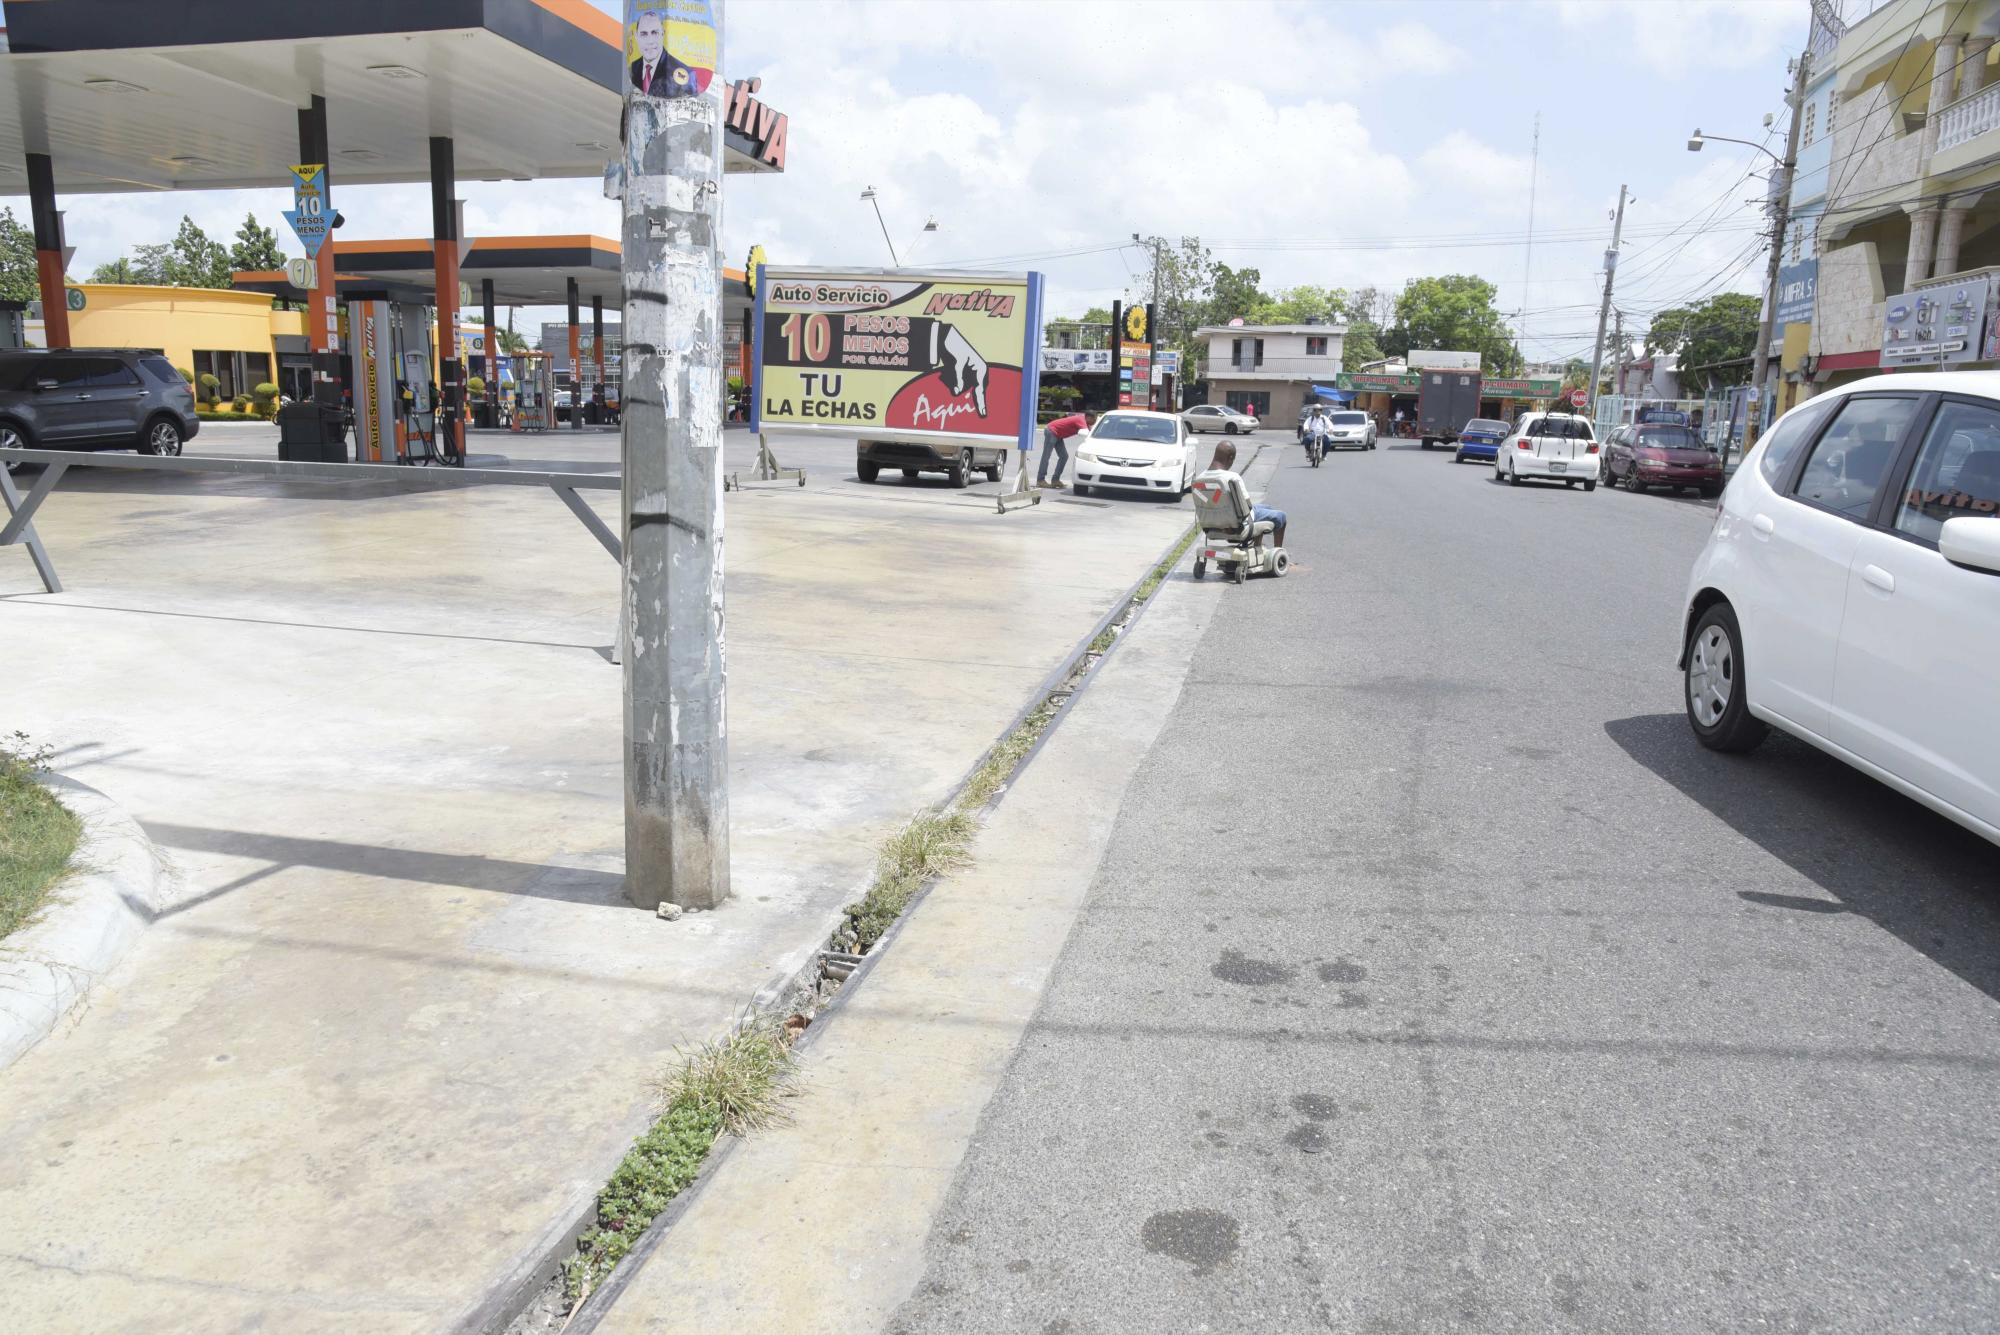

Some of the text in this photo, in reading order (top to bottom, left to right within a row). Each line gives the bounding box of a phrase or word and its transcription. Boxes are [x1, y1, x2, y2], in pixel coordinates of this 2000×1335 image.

[297, 197, 321, 217] 10
[297, 226, 326, 234] MENOS
[772, 286, 888, 304] Auto Servicio
[844, 314, 910, 334] PESOS
[780, 313, 831, 362] 10
[842, 335, 909, 354] MENOS
[842, 354, 909, 366] POR GALÓN
[367, 364, 378, 415] Servicio
[800, 373, 842, 397] TU
[766, 398, 877, 420] LA ECHAS
[370, 420, 379, 448] Auto
